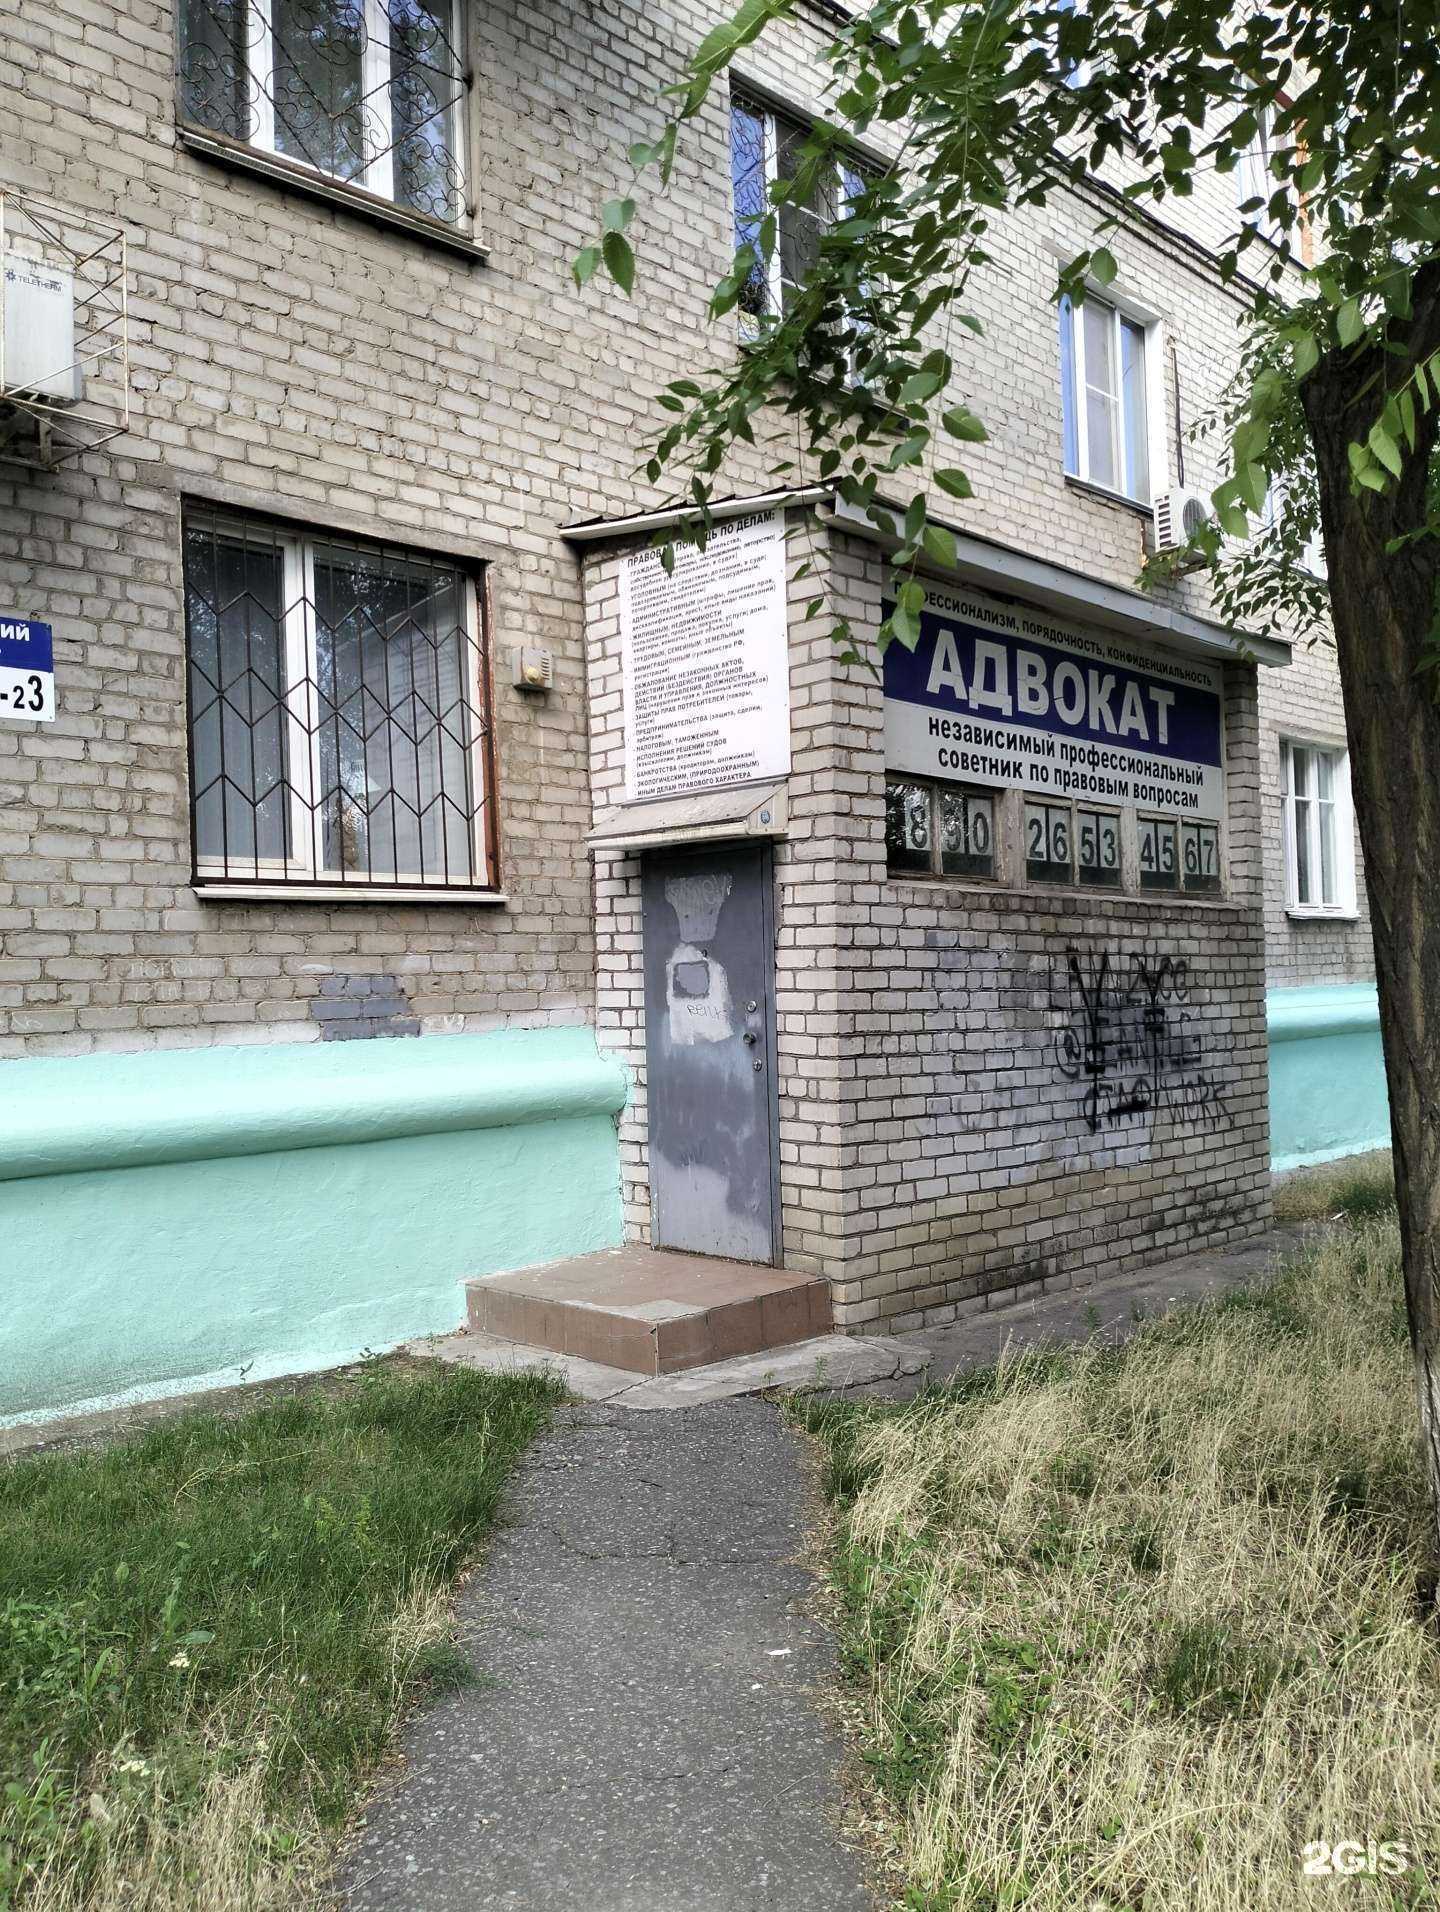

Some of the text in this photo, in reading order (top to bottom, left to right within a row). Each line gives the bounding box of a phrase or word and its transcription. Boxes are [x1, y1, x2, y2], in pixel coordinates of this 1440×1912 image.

[627, 545, 667, 568] ПРАВОВА
[676, 528, 716, 552] ПОМЩЬ
[736, 510, 774, 533] ДЕЛАМ:
[631, 584, 665, 600] УГОЛОВНЫМ
[631, 599, 695, 623] АДМИНИСТРАТИВНЫМ
[727, 582, 755, 595] лишение
[671, 608, 721, 630] НЕДВИЖИМОСТИ
[0, 622, 31, 642] ий
[704, 627, 744, 644] ЗЕМЕЛЬНЫМ
[894, 582, 1214, 687] ПЕССИОНАЛИЗМ, ПОРЯДОЧНОСТЬ, КОНФИДЕНЦИАЛЬНОСТЬ
[633, 652, 690, 673] ИММИГРАЦИОННЫМ
[634, 656, 744, 690] ОБЖАЛОВАНИЕ НЕЗАКОННЫХ АКТОВ,
[713, 665, 742, 678] ОРГАНОВ
[635, 694, 656, 705] ВЛАСТИ
[664, 683, 703, 698] УПРАВЛЕНИЯ,
[705, 670, 756, 688] ДОЛЖНОСТНЫХ
[635, 703, 646, 711] ЛИЦ
[733, 673, 768, 690] интересов)
[926, 628, 1176, 746] АДВОКАТ
[635, 708, 659, 720] ЗАЩИТЫ
[660, 704, 676, 714] ПРАВ
[677, 693, 724, 710] ПОТРЕБИТЕЛЕЙ
[635, 714, 707, 736] ПРЕДПРИНИМАТЕЛЬСТВА
[674, 730, 718, 744] ТАМОЖЕННЫМ
[636, 737, 726, 761] ИСПОЛНЕНИЯ РЕШЕНИЙ СУДОВ
[928, 715, 1205, 787] независимый профессиональный
[636, 764, 676, 777] БАНКРОТСТВА
[689, 759, 759, 778] (ПРИРОДООХРАННЫМ)
[938, 746, 1200, 810] советник по правовым вопросам
[637, 770, 751, 796] ИНЫМ ДЕЛАМ ПРАВОВОГО ХАРАКТЕРА
